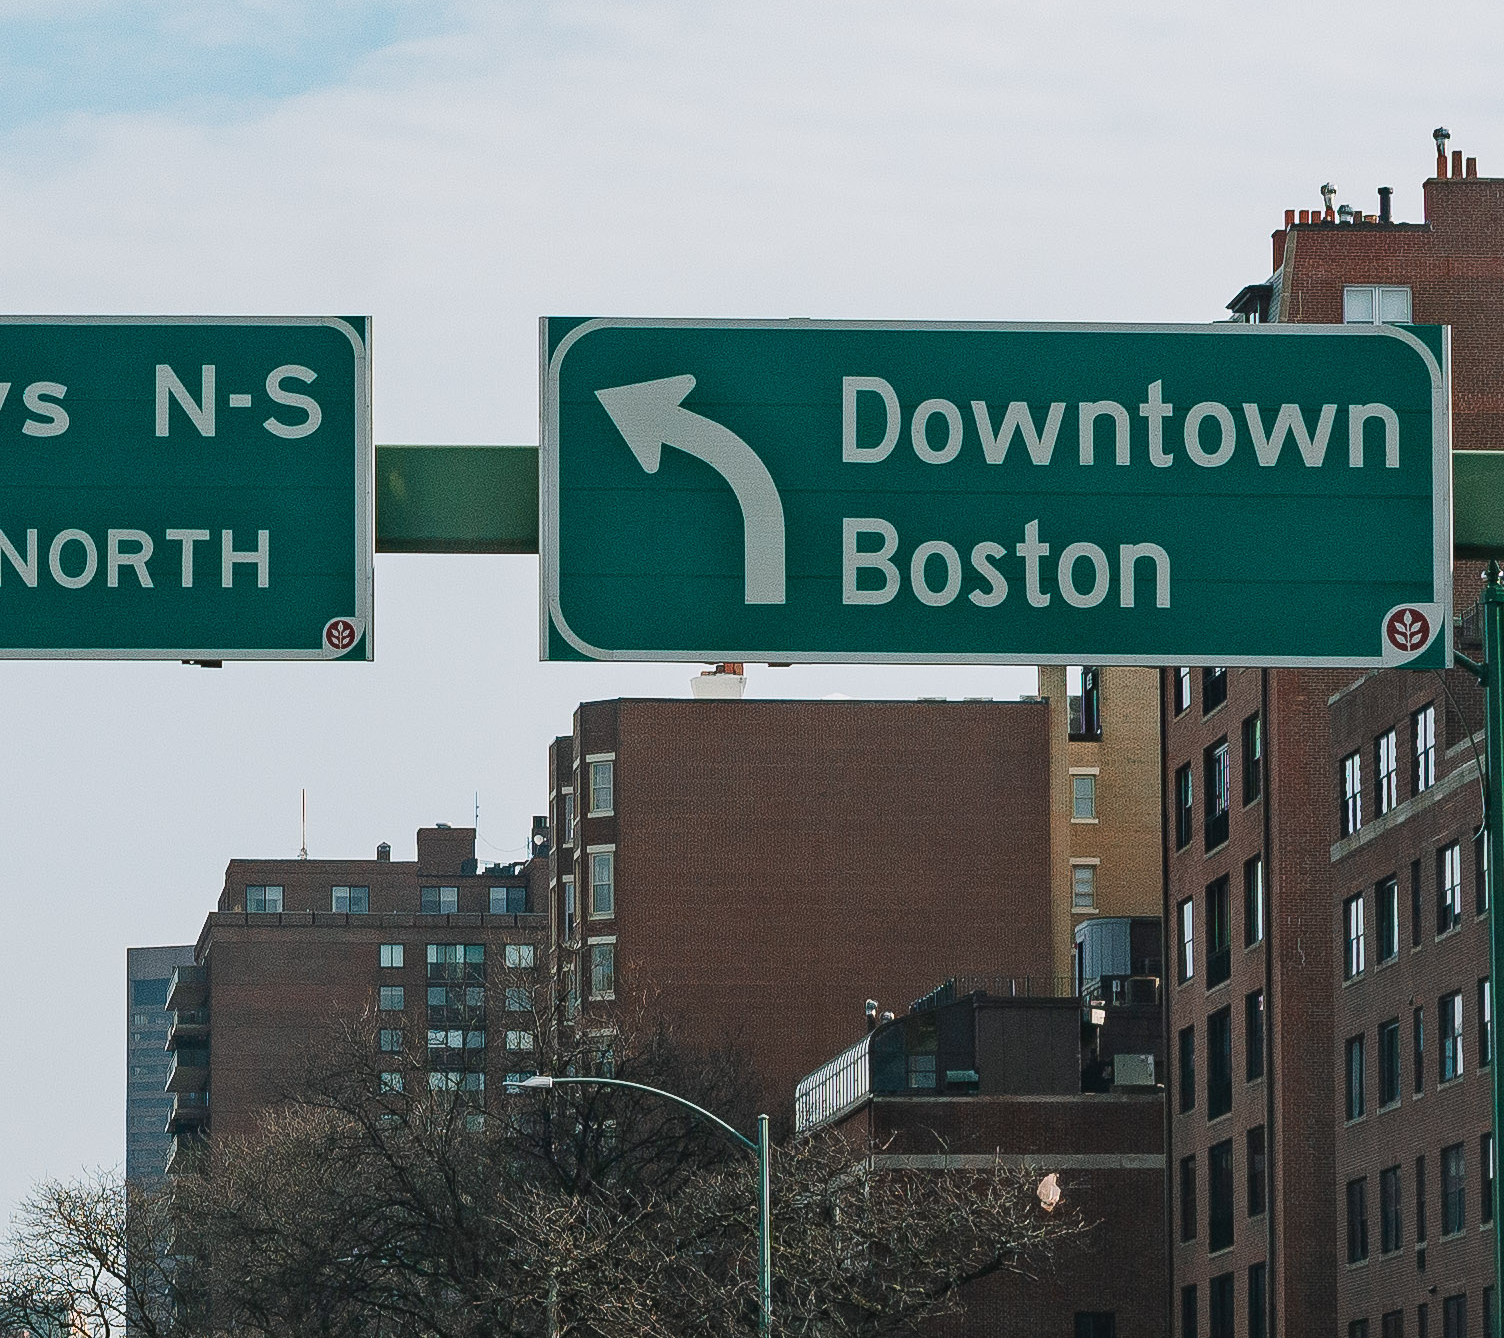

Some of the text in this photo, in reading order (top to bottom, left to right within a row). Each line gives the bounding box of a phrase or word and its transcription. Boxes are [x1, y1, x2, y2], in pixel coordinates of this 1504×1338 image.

[156, 364, 322, 438] N-S
[843, 376, 1399, 468] Downtown
[843, 518, 1170, 608] Boston
